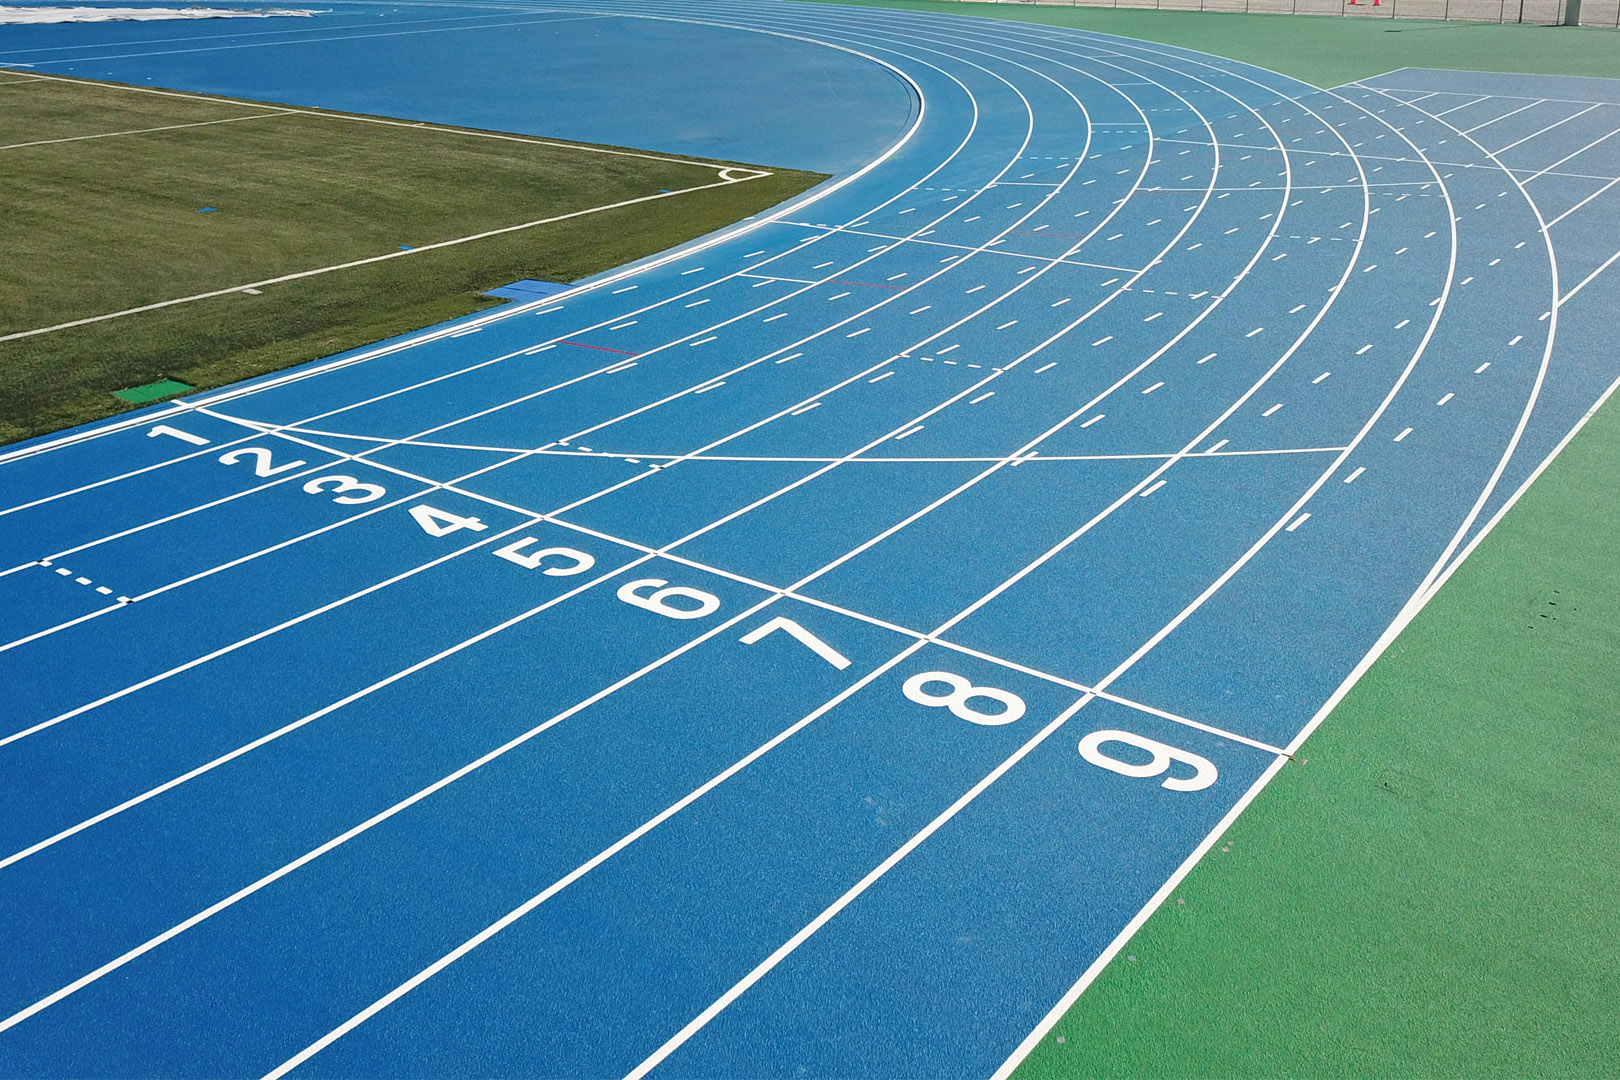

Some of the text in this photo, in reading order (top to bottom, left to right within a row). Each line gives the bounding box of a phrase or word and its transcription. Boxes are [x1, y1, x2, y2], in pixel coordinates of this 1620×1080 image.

[146, 424, 210, 446] 1
[218, 447, 307, 478] 2
[302, 475, 387, 505] 3
[407, 504, 489, 538] 4
[492, 536, 596, 577] 5
[616, 578, 721, 620] 6
[738, 615, 852, 671] 7
[902, 670, 1027, 726] 8
[1077, 729, 1219, 792] 9
